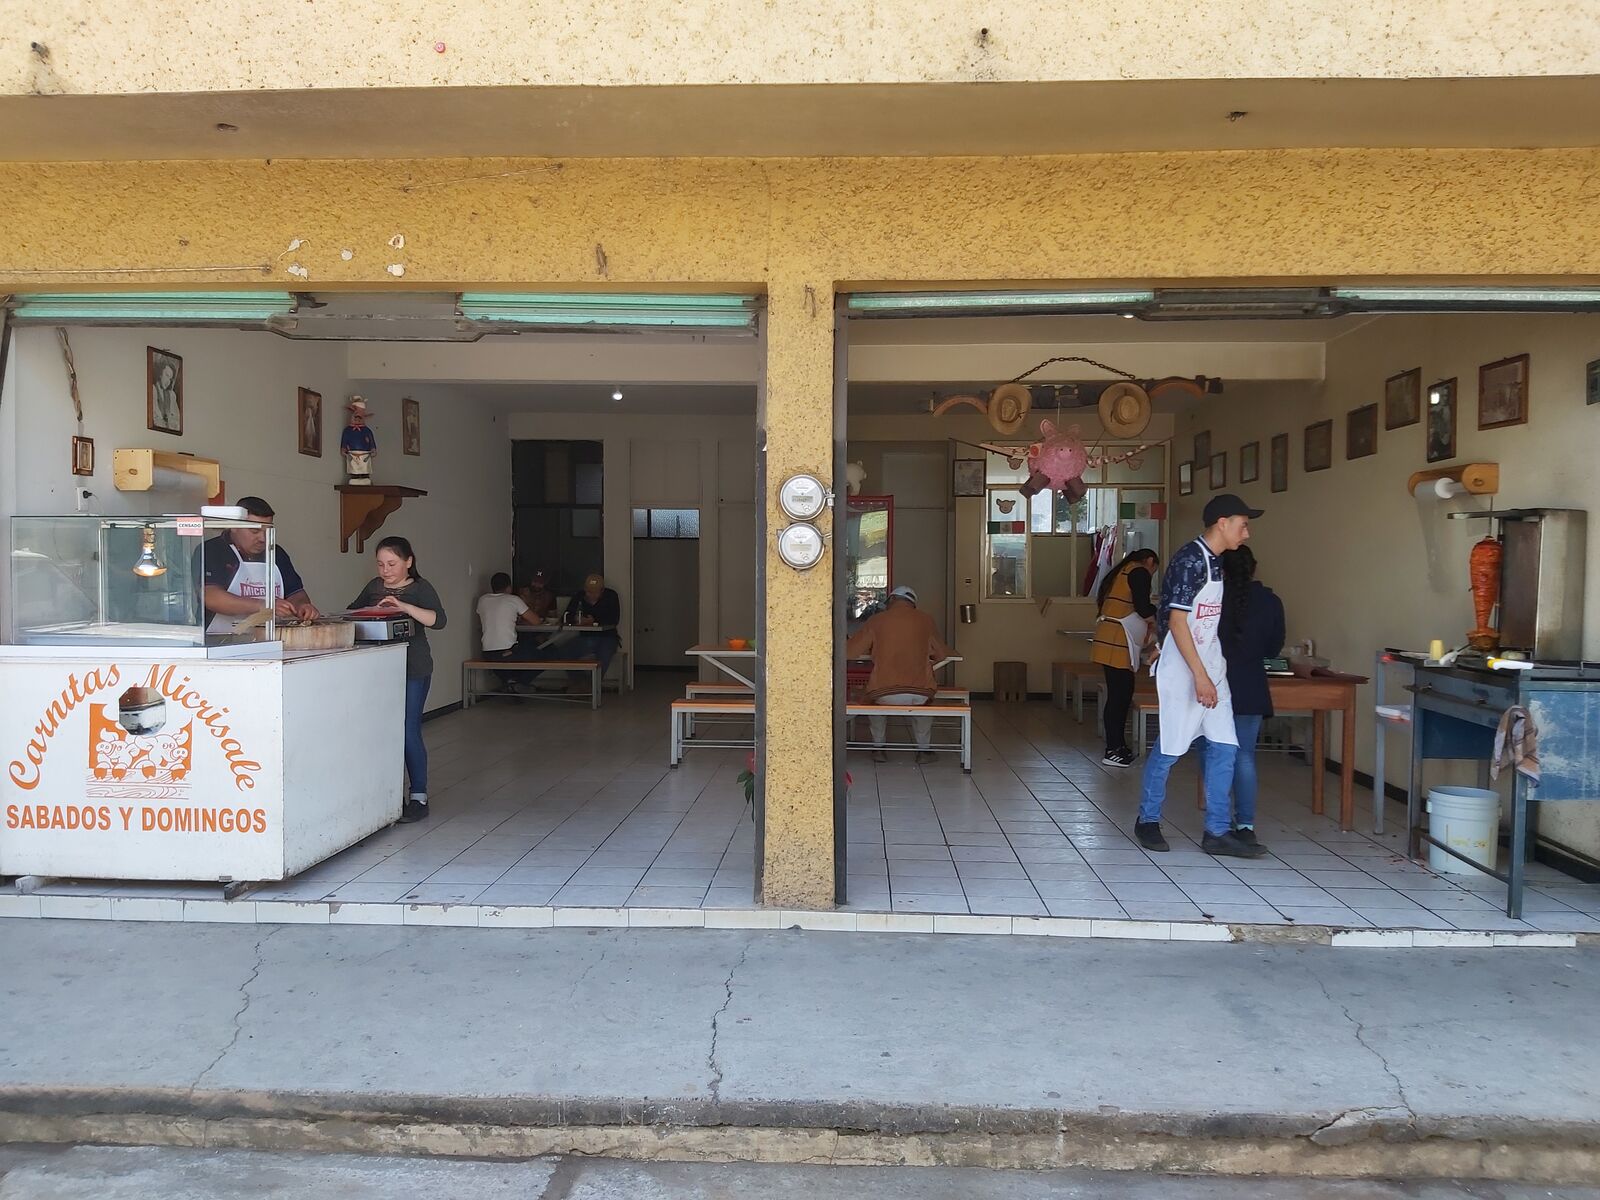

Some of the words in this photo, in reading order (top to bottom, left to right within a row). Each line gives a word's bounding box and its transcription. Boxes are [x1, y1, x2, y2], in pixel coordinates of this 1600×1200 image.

[9, 663, 120, 790] Carnitas
[132, 663, 261, 792] Micrisale
[6, 804, 112, 831] SABADOS
[118, 806, 134, 831] Y
[141, 807, 267, 834] DOMINGOS
